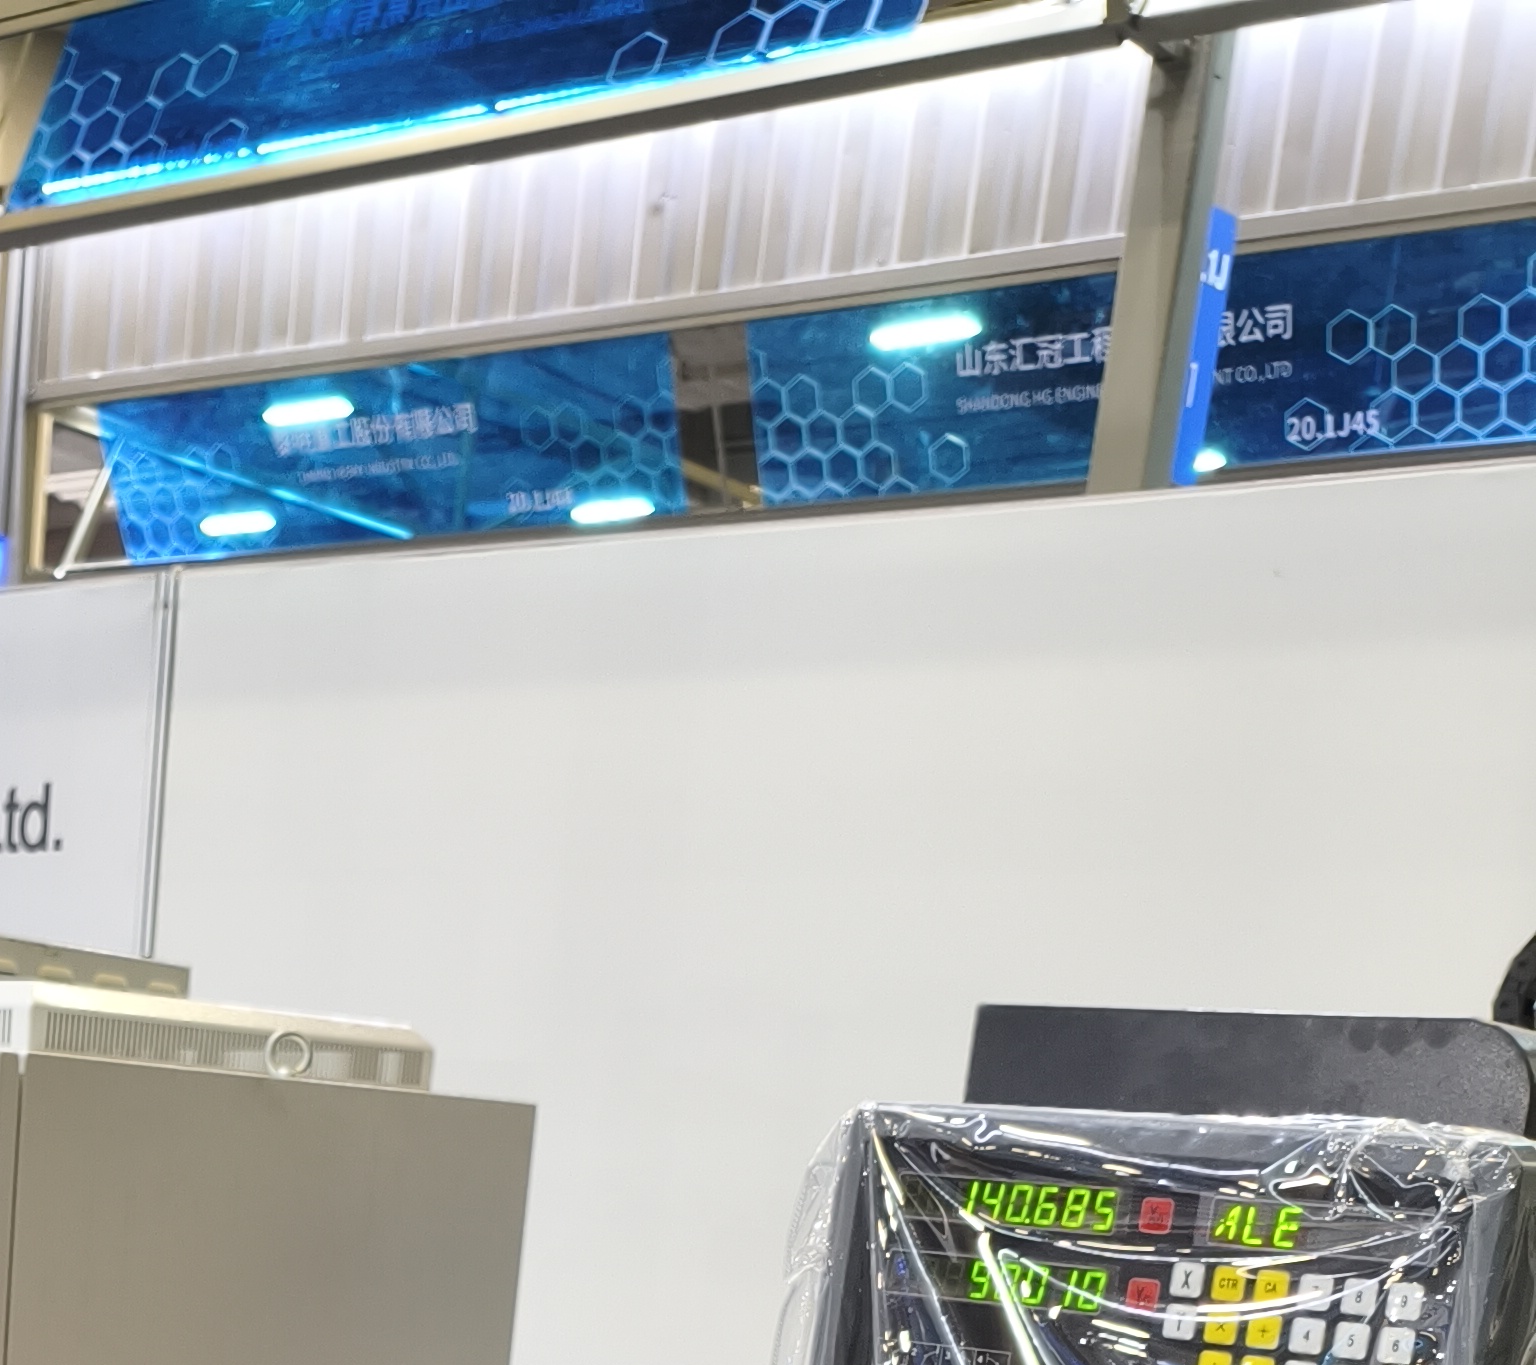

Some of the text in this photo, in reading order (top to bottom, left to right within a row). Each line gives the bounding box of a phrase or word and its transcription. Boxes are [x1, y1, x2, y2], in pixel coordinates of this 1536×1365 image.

[1180, 1268, 1193, 1290] X
[1218, 1277, 1239, 1291] CTR
[1354, 1290, 1363, 1304] 8
[1400, 1294, 1409, 1308] 9
[1302, 1329, 1311, 1342] 4
[1346, 1333, 1355, 1348] 5
[1391, 1338, 1400, 1352] 6
